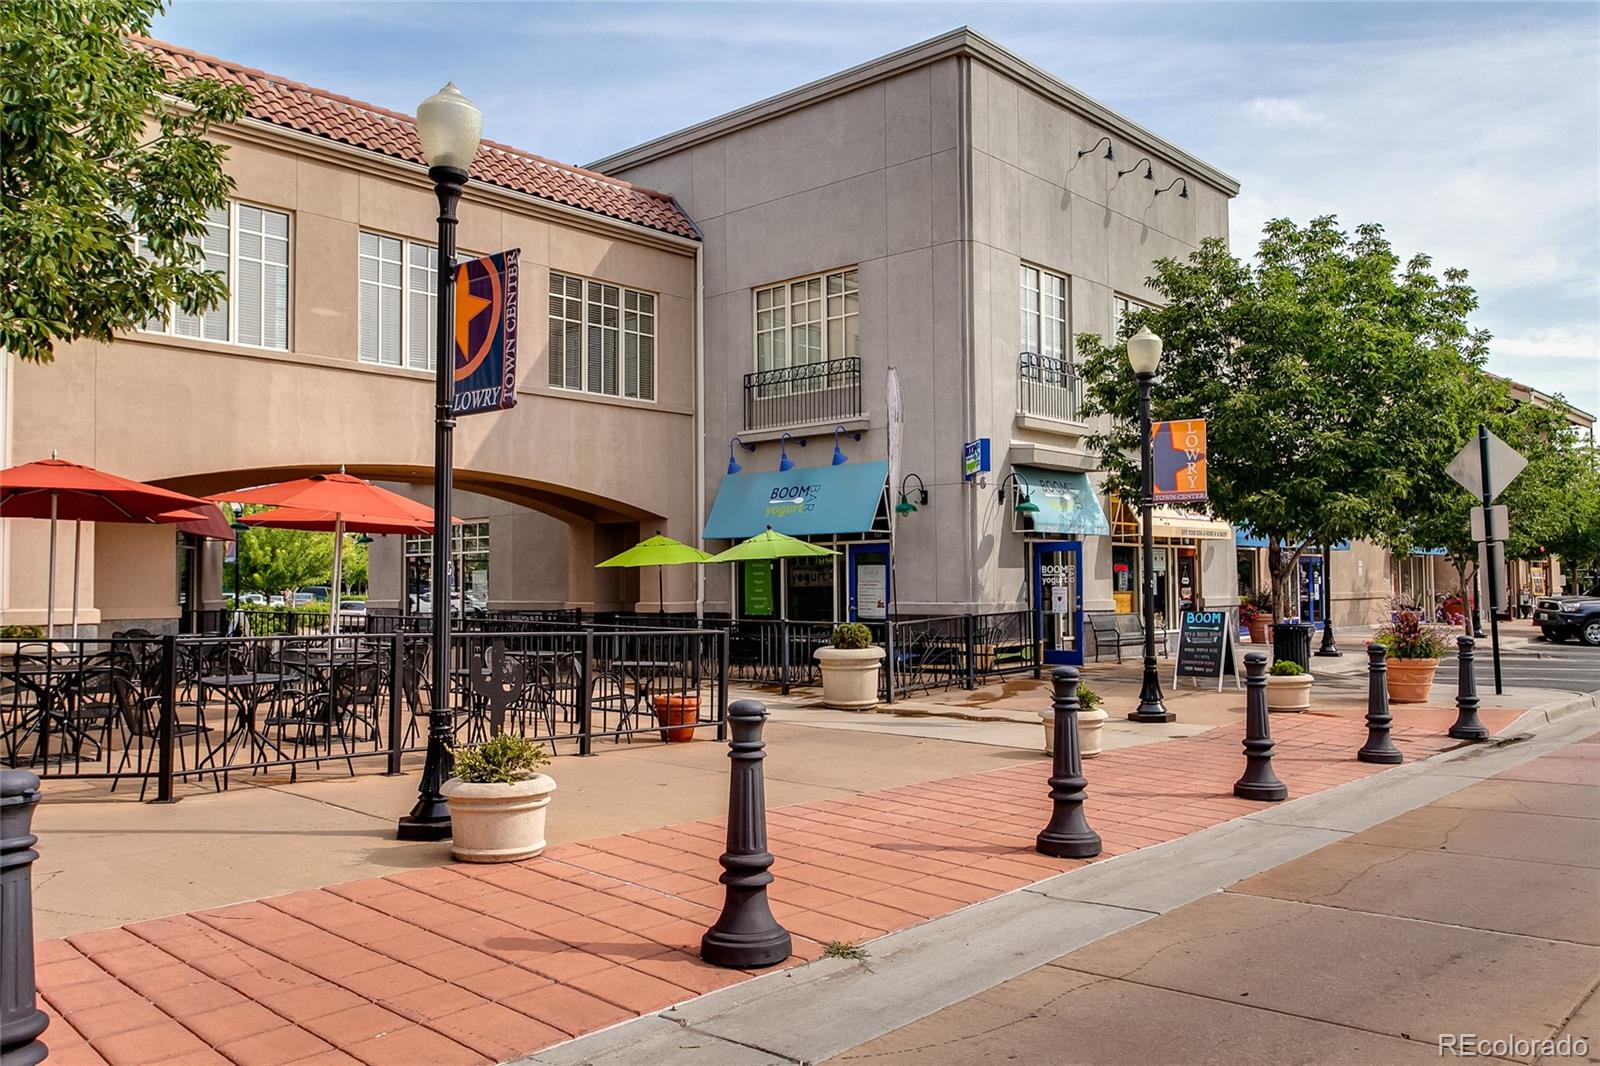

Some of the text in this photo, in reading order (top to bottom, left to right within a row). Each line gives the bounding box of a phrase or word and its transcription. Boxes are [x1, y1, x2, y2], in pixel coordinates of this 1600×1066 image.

[503, 252, 518, 402] TOWN CENTER
[453, 386, 501, 411] LOWRY
[1184, 421, 1200, 488] LOWRY
[770, 485, 810, 499] BOOM
[1040, 480, 1069, 493] BOOM
[1177, 492, 1206, 500] CENTER
[1041, 565, 1068, 574] BOOM
[1186, 612, 1222, 624] BOOM
